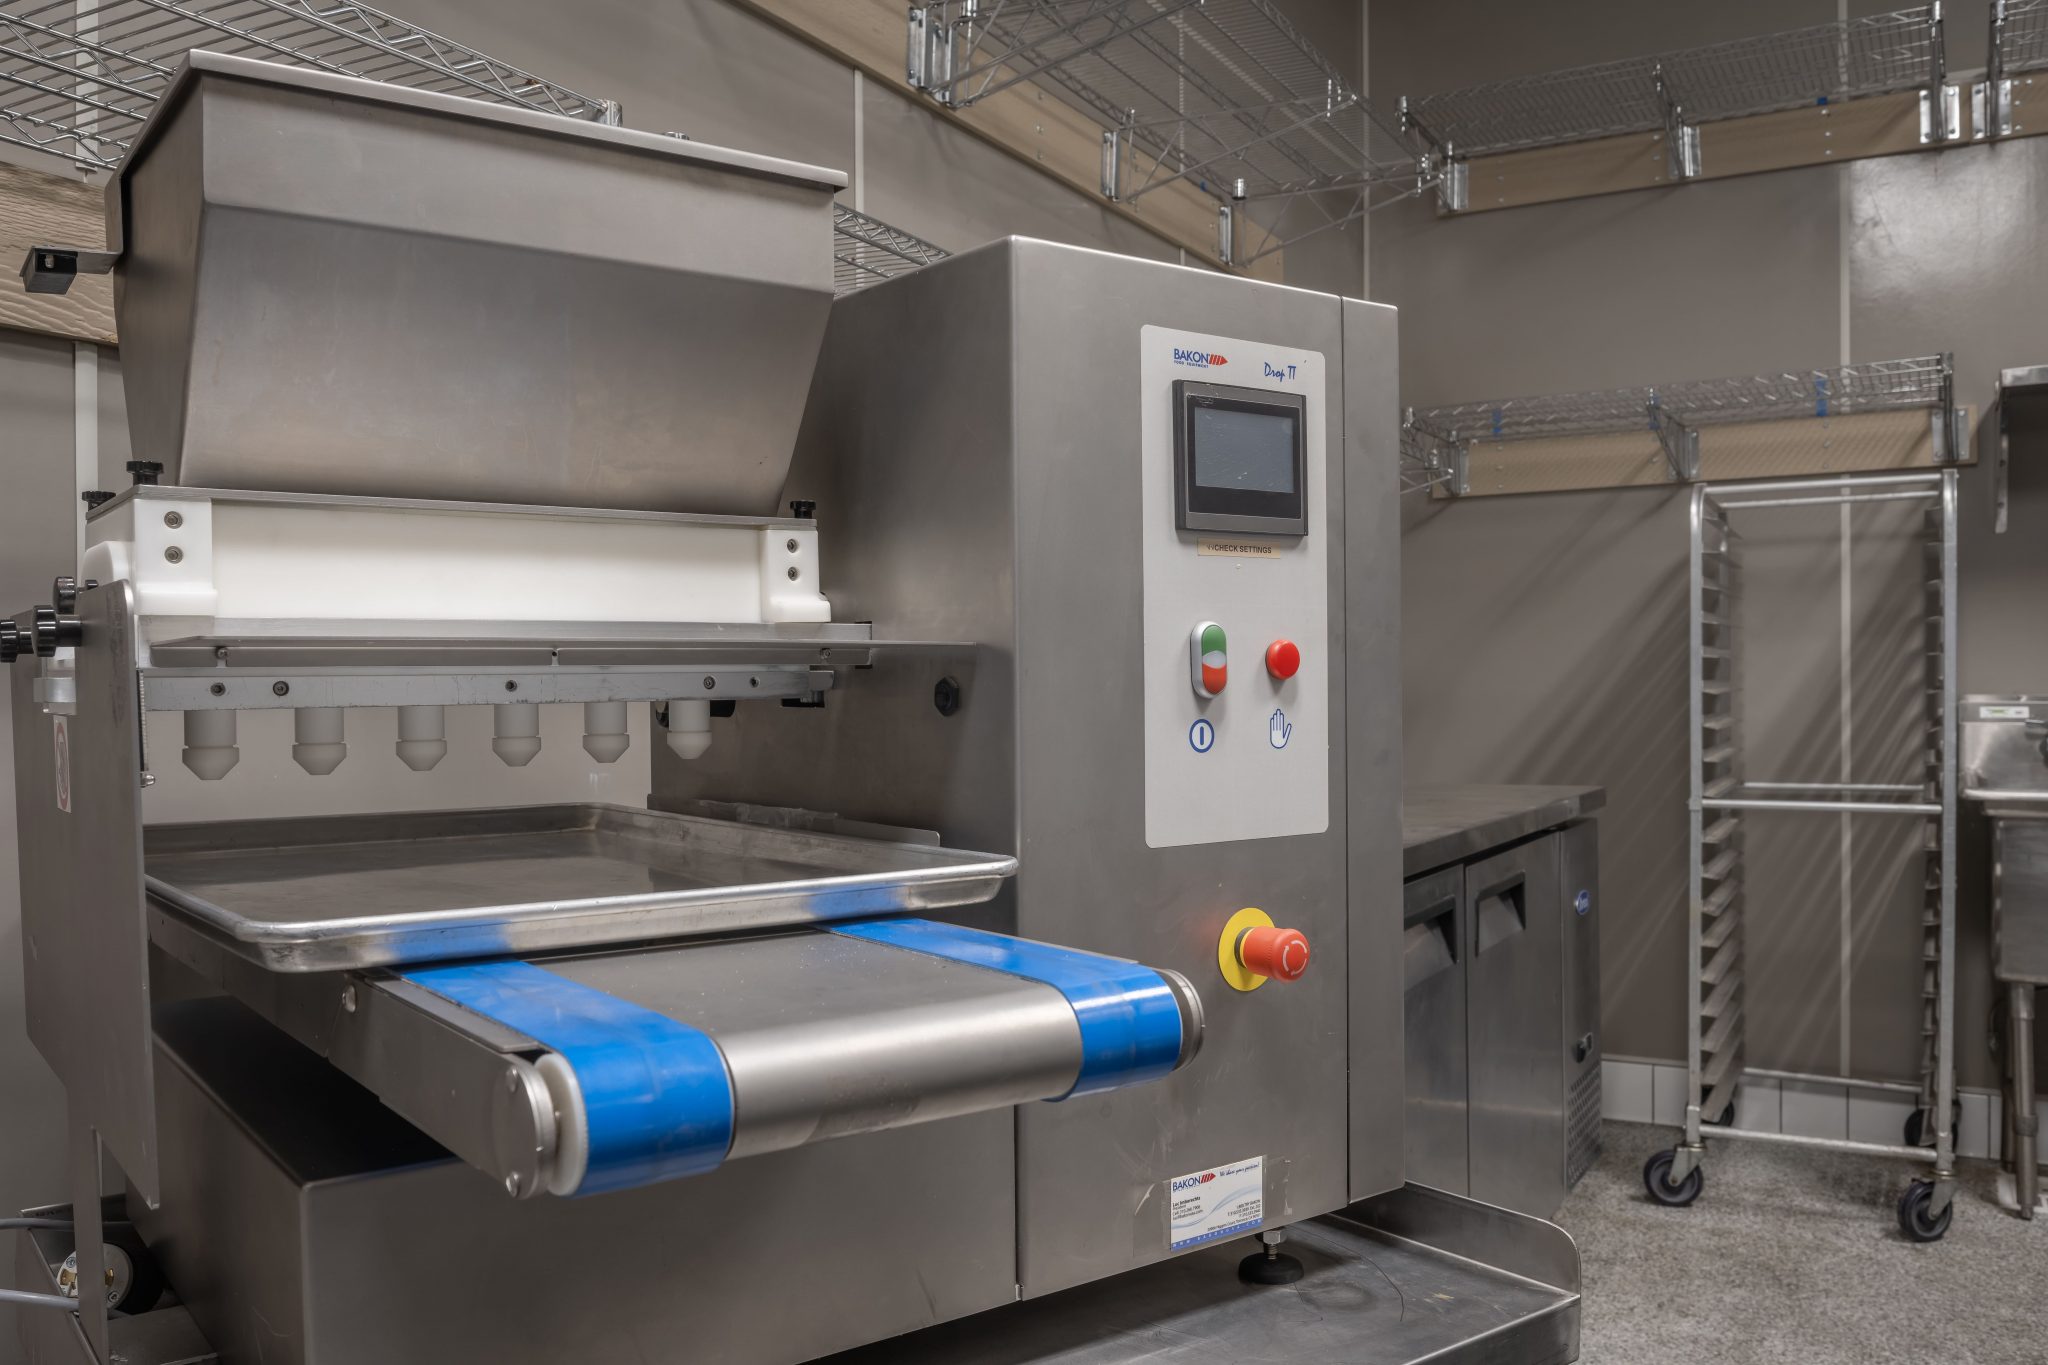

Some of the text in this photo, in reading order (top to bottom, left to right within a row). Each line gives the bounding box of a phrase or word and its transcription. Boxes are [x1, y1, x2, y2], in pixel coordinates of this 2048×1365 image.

[1174, 348, 1209, 364] BAKON
[1264, 362, 1286, 382] Drop
[1239, 545, 1272, 554] SETTINGS
[1172, 1176, 1200, 1191] BAKON
